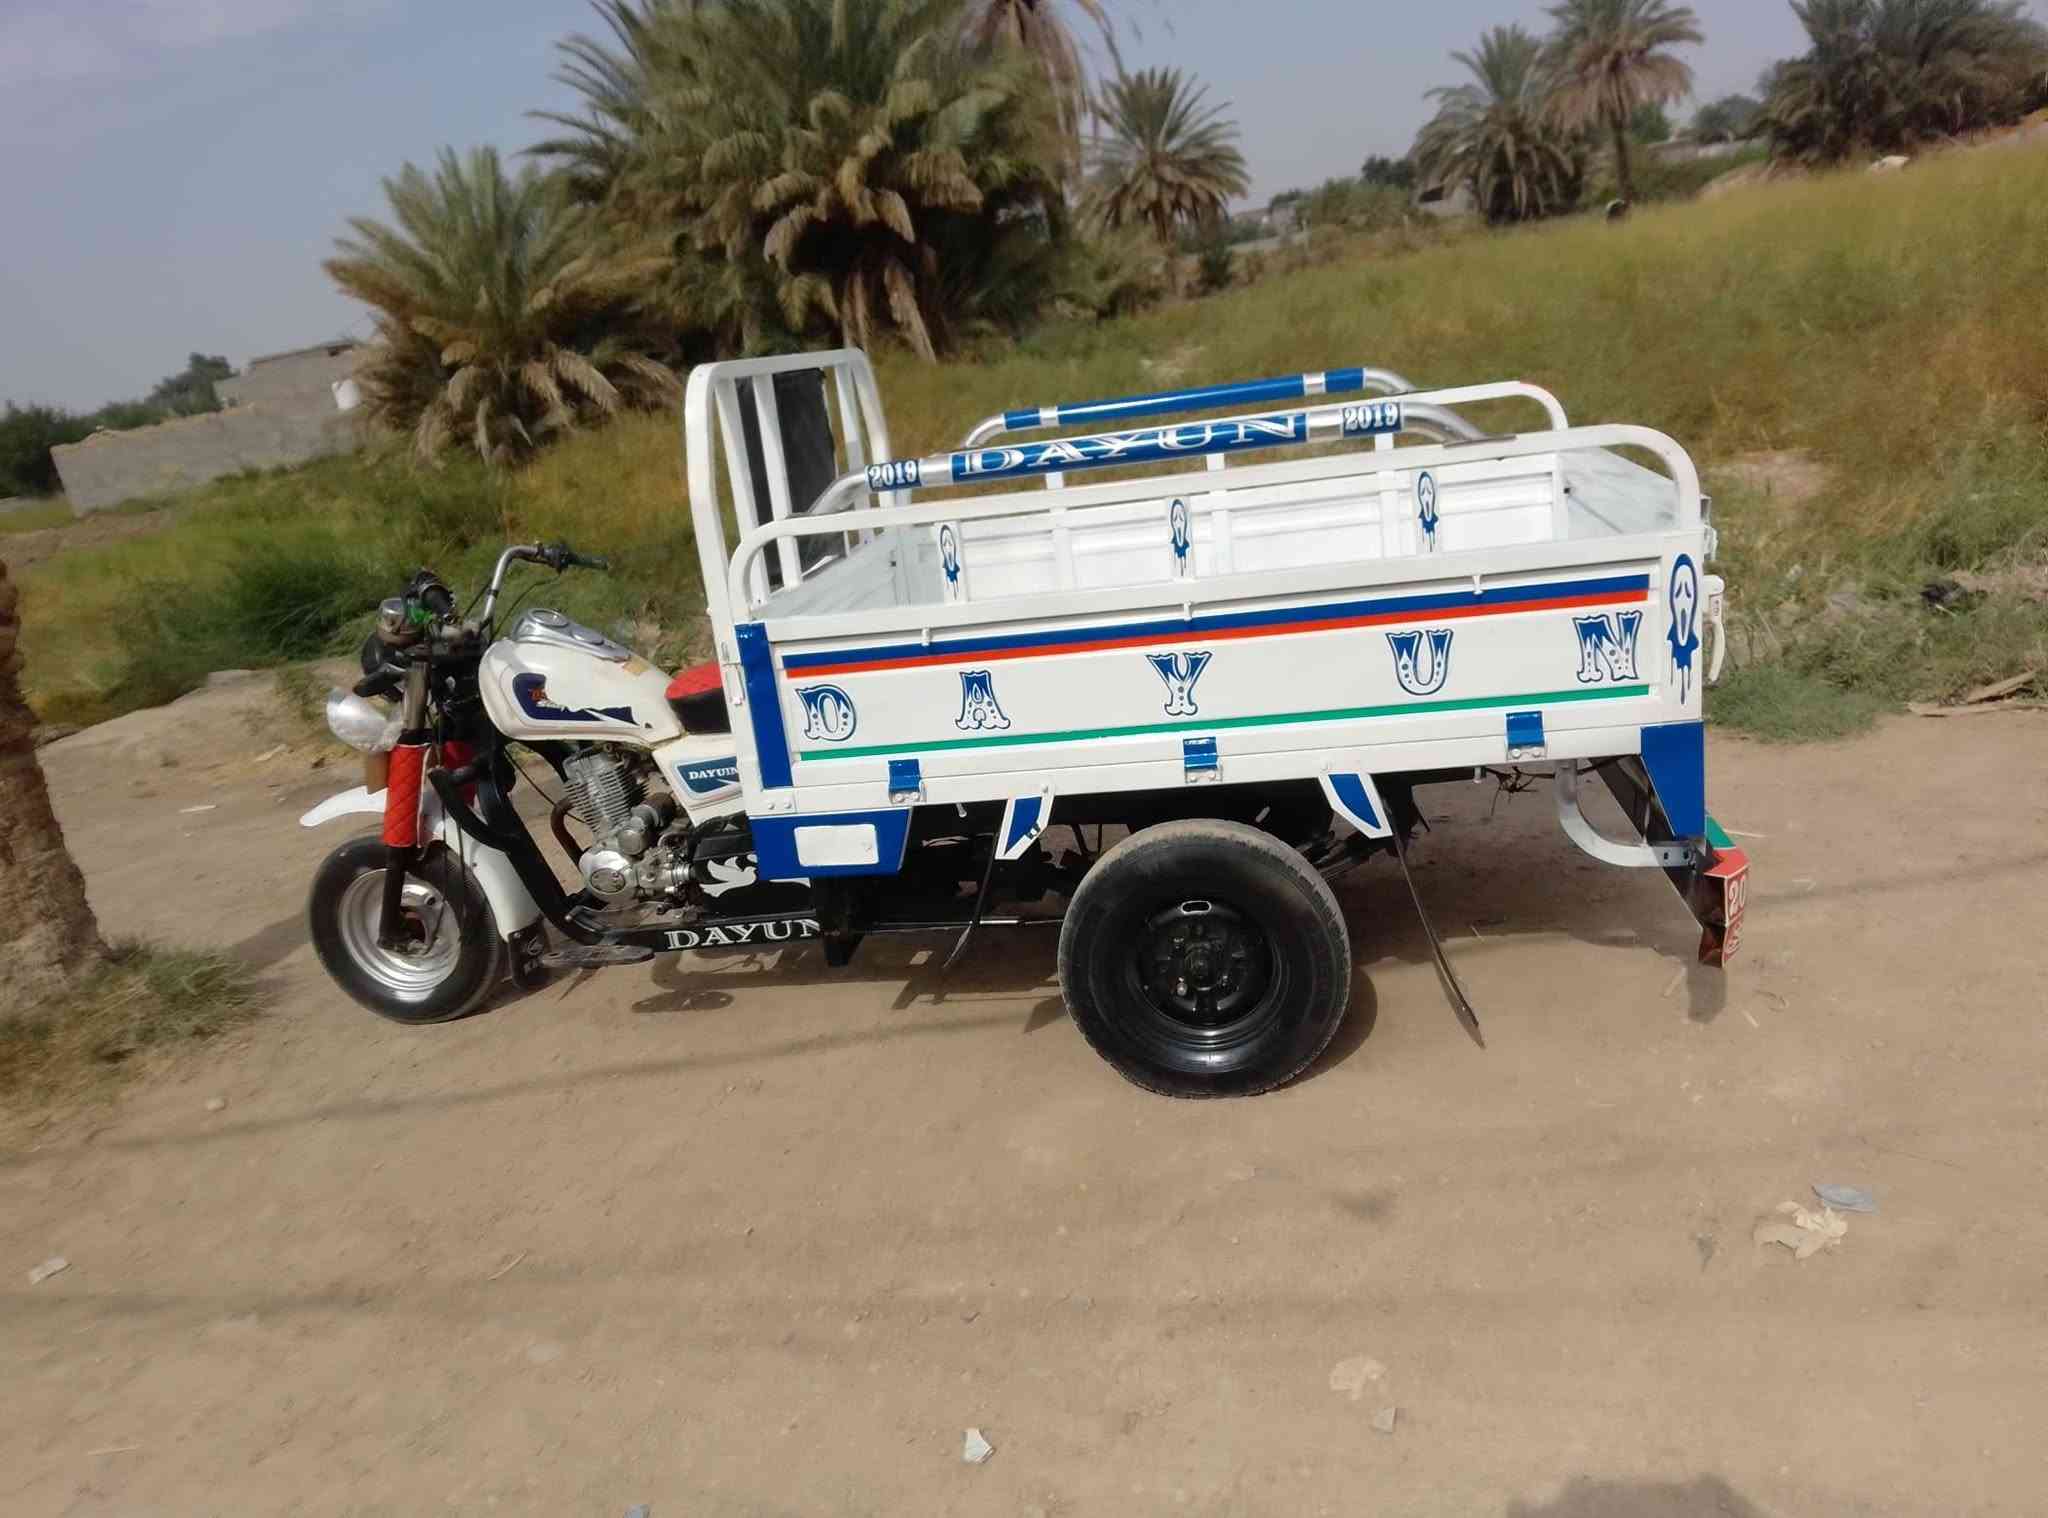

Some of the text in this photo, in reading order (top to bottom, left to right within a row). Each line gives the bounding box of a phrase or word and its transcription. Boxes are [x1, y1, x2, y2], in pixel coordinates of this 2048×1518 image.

[868, 402, 1399, 488] 2019 DAYUN 2019
[794, 610, 1643, 743] DAYUN
